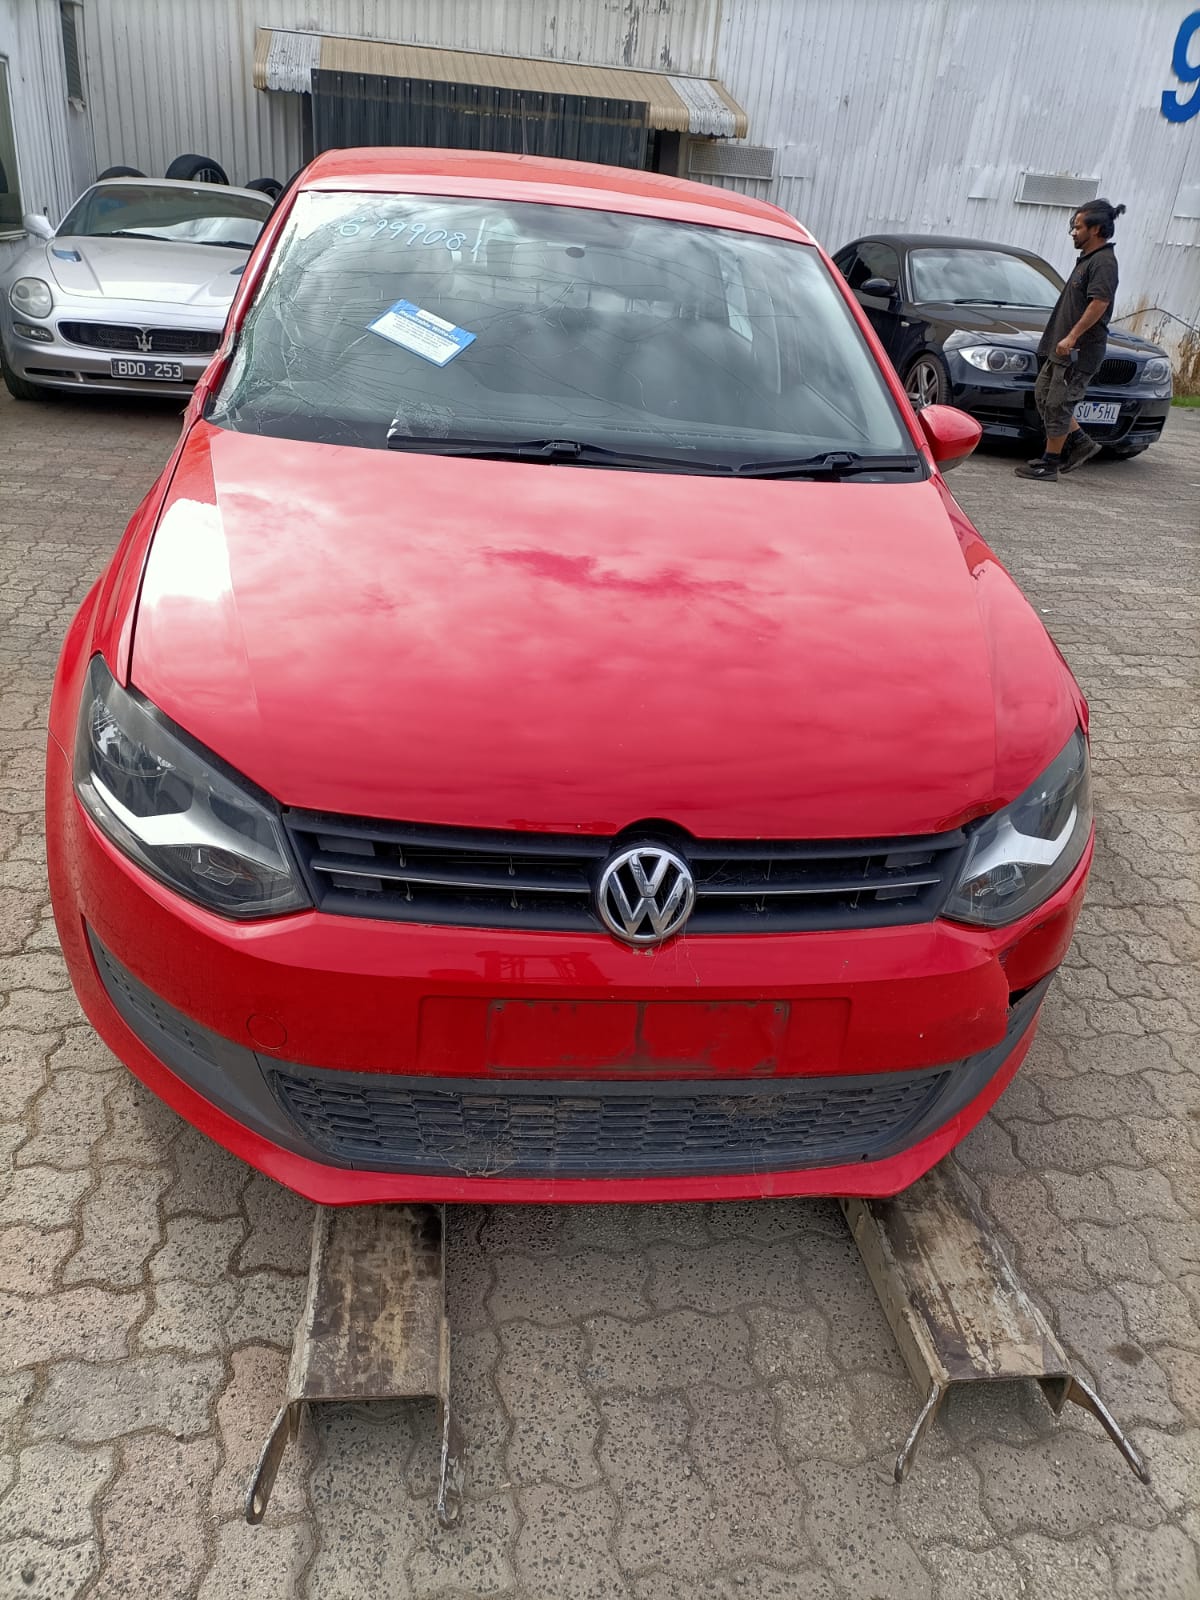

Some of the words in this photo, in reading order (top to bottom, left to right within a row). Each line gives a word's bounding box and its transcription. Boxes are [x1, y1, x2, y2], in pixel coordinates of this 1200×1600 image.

[1160, 9, 1200, 123] 9
[154, 363, 181, 378] 253
[602, 850, 692, 940] VW
